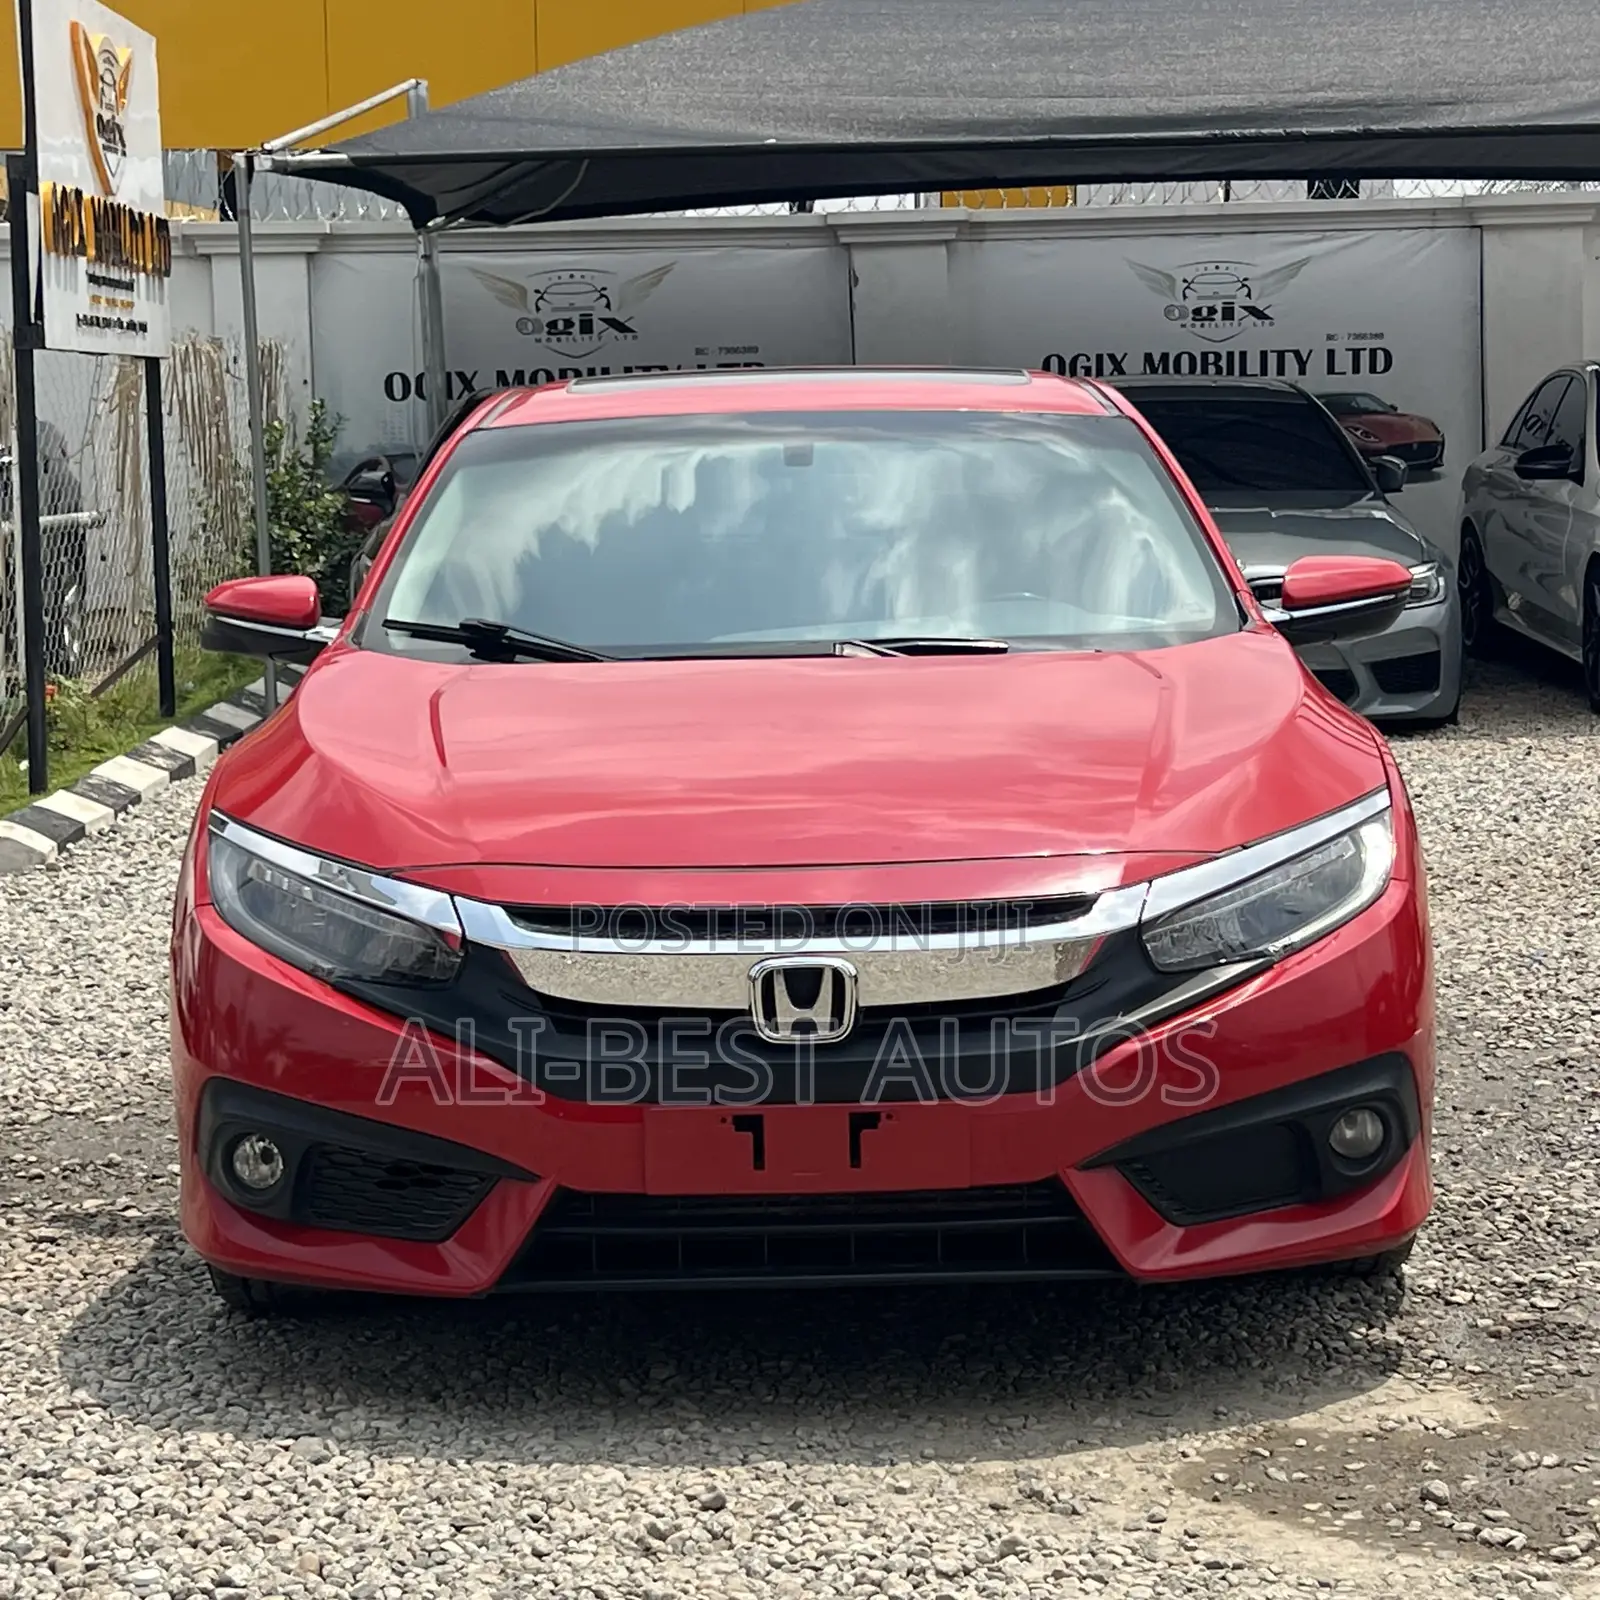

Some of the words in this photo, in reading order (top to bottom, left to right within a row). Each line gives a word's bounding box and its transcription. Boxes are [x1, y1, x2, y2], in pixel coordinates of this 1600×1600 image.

[1042, 353, 1128, 378] OGIX
[1142, 349, 1312, 377] MOBILITY
[1326, 347, 1393, 375] LTD
